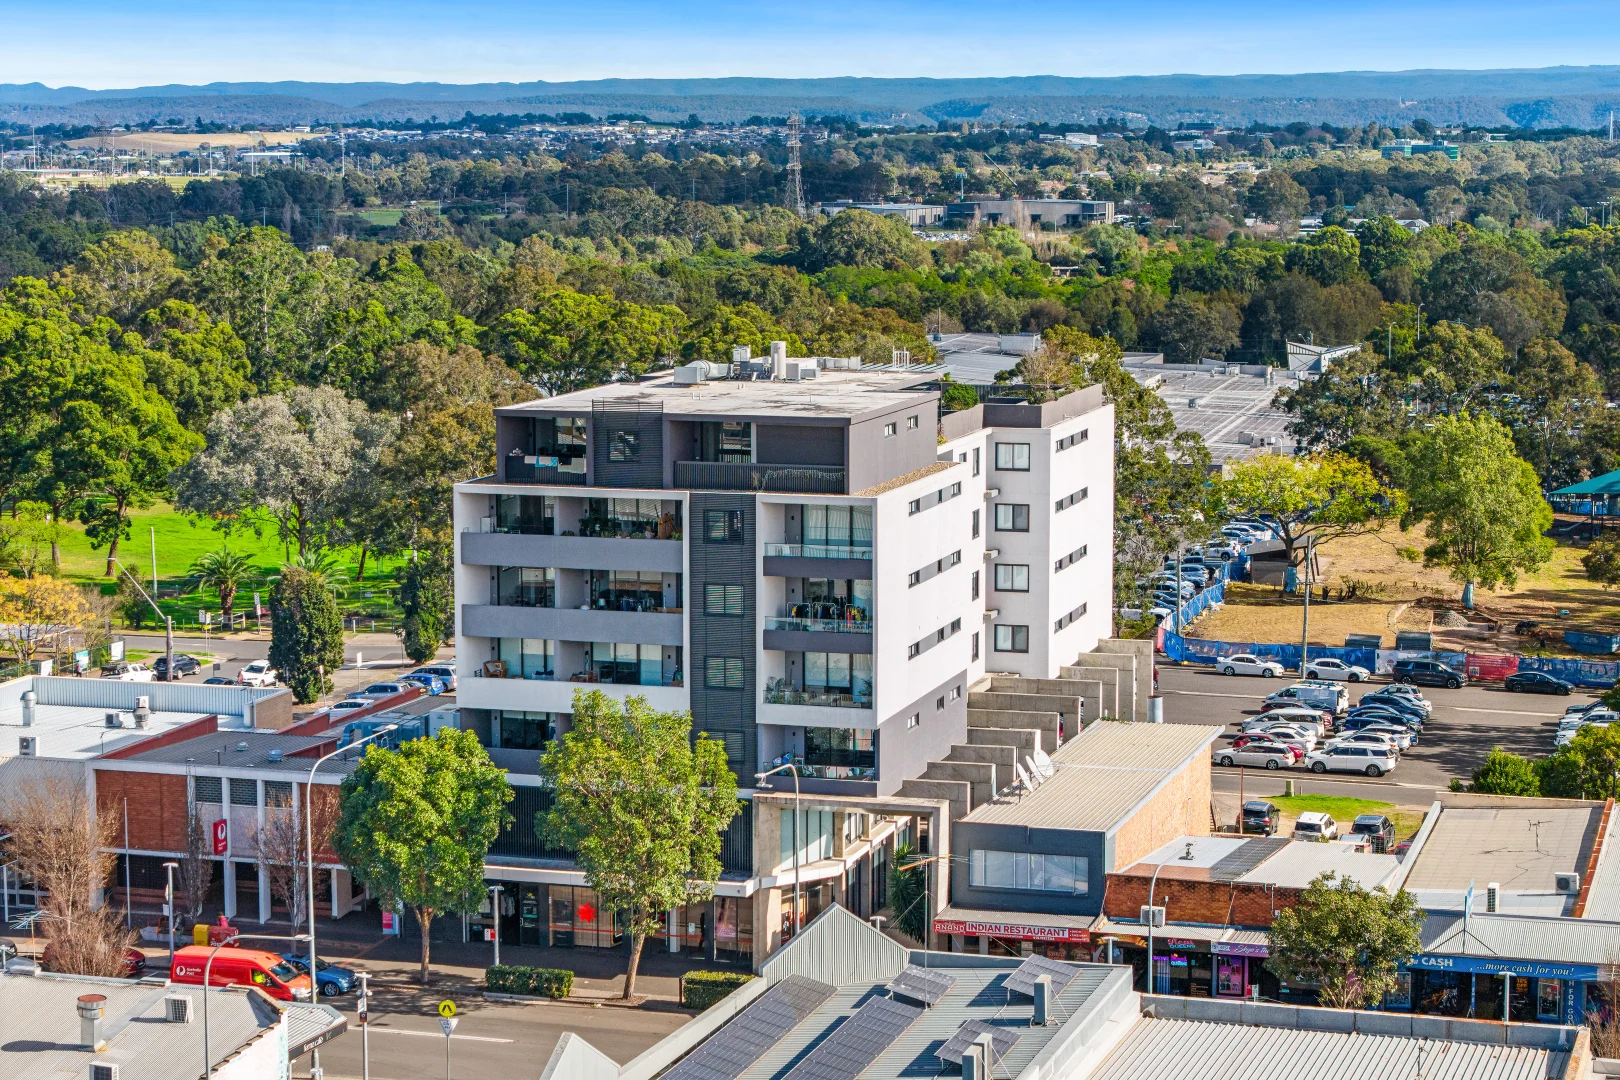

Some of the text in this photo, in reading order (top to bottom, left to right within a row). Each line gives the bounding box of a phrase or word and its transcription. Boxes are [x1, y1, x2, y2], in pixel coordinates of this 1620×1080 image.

[968, 923, 1001, 933] INDIAN
[1003, 925, 1066, 936] RESTAURANT
[1421, 957, 1453, 967] CASH
[1511, 964, 1533, 973] cash
[1534, 965, 1550, 975] for
[1551, 967, 1575, 977] you!
